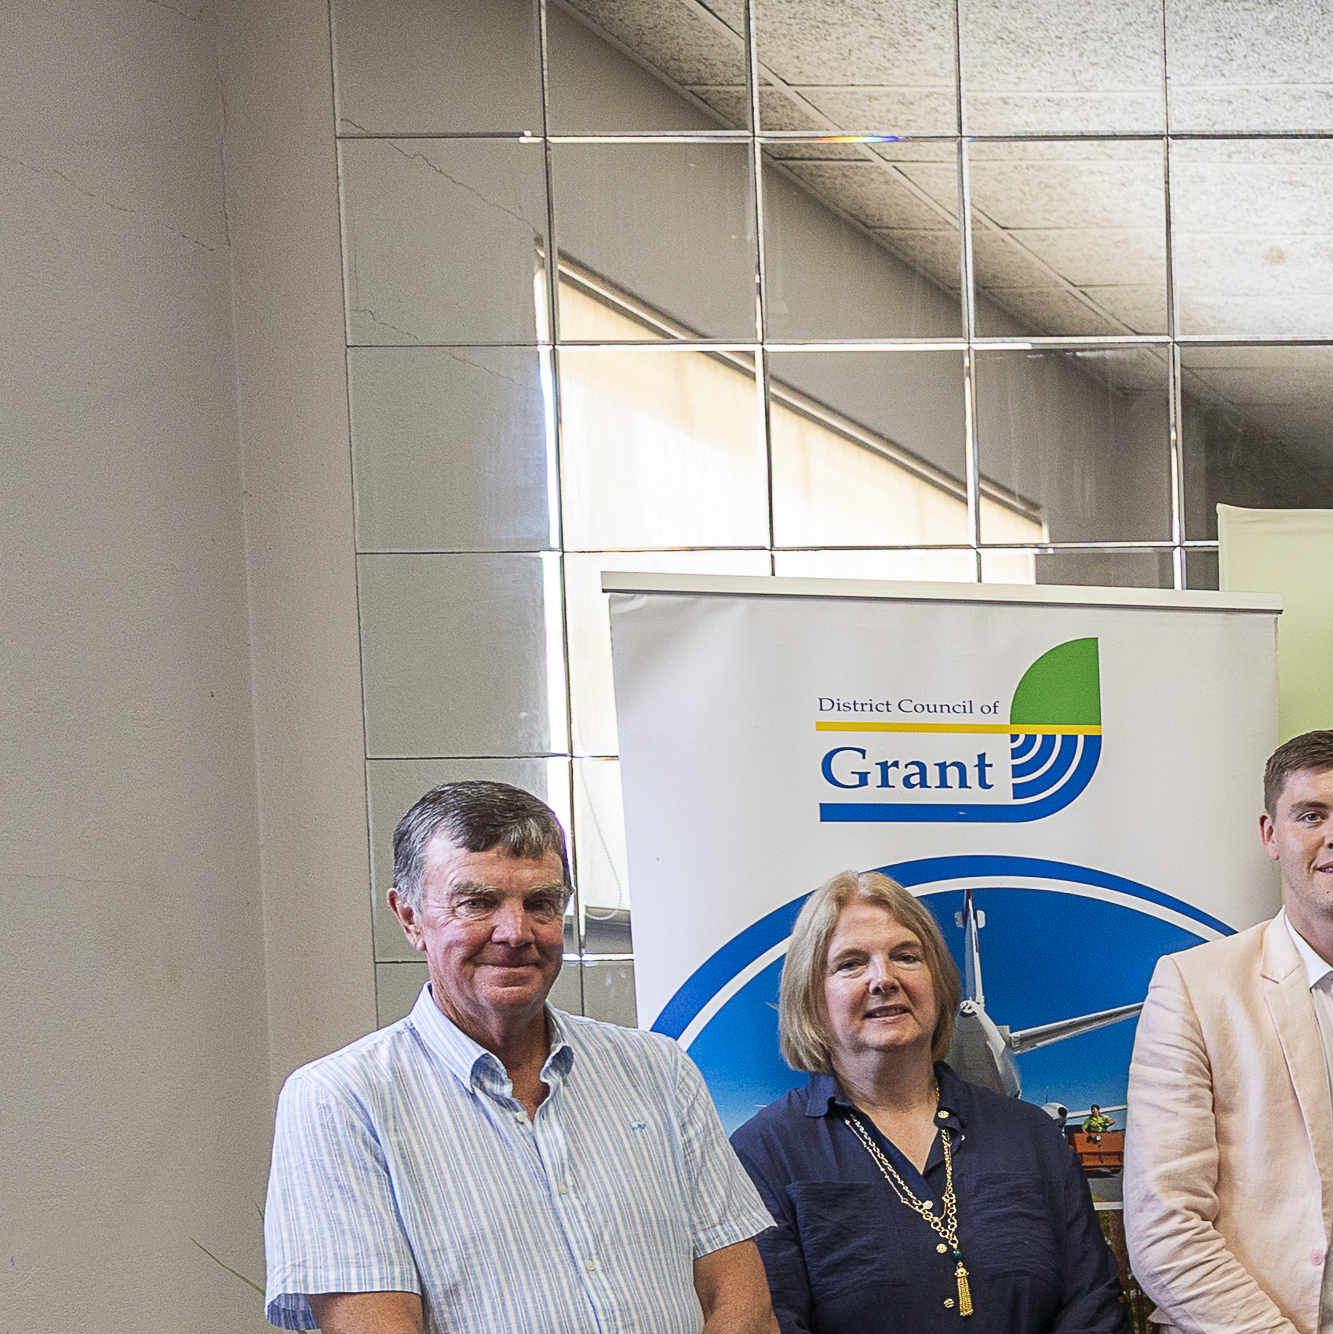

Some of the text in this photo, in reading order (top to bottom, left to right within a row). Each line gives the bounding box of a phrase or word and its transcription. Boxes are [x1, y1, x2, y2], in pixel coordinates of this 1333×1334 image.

[817, 696, 1000, 715] District Council of
[820, 746, 995, 790] Grant
